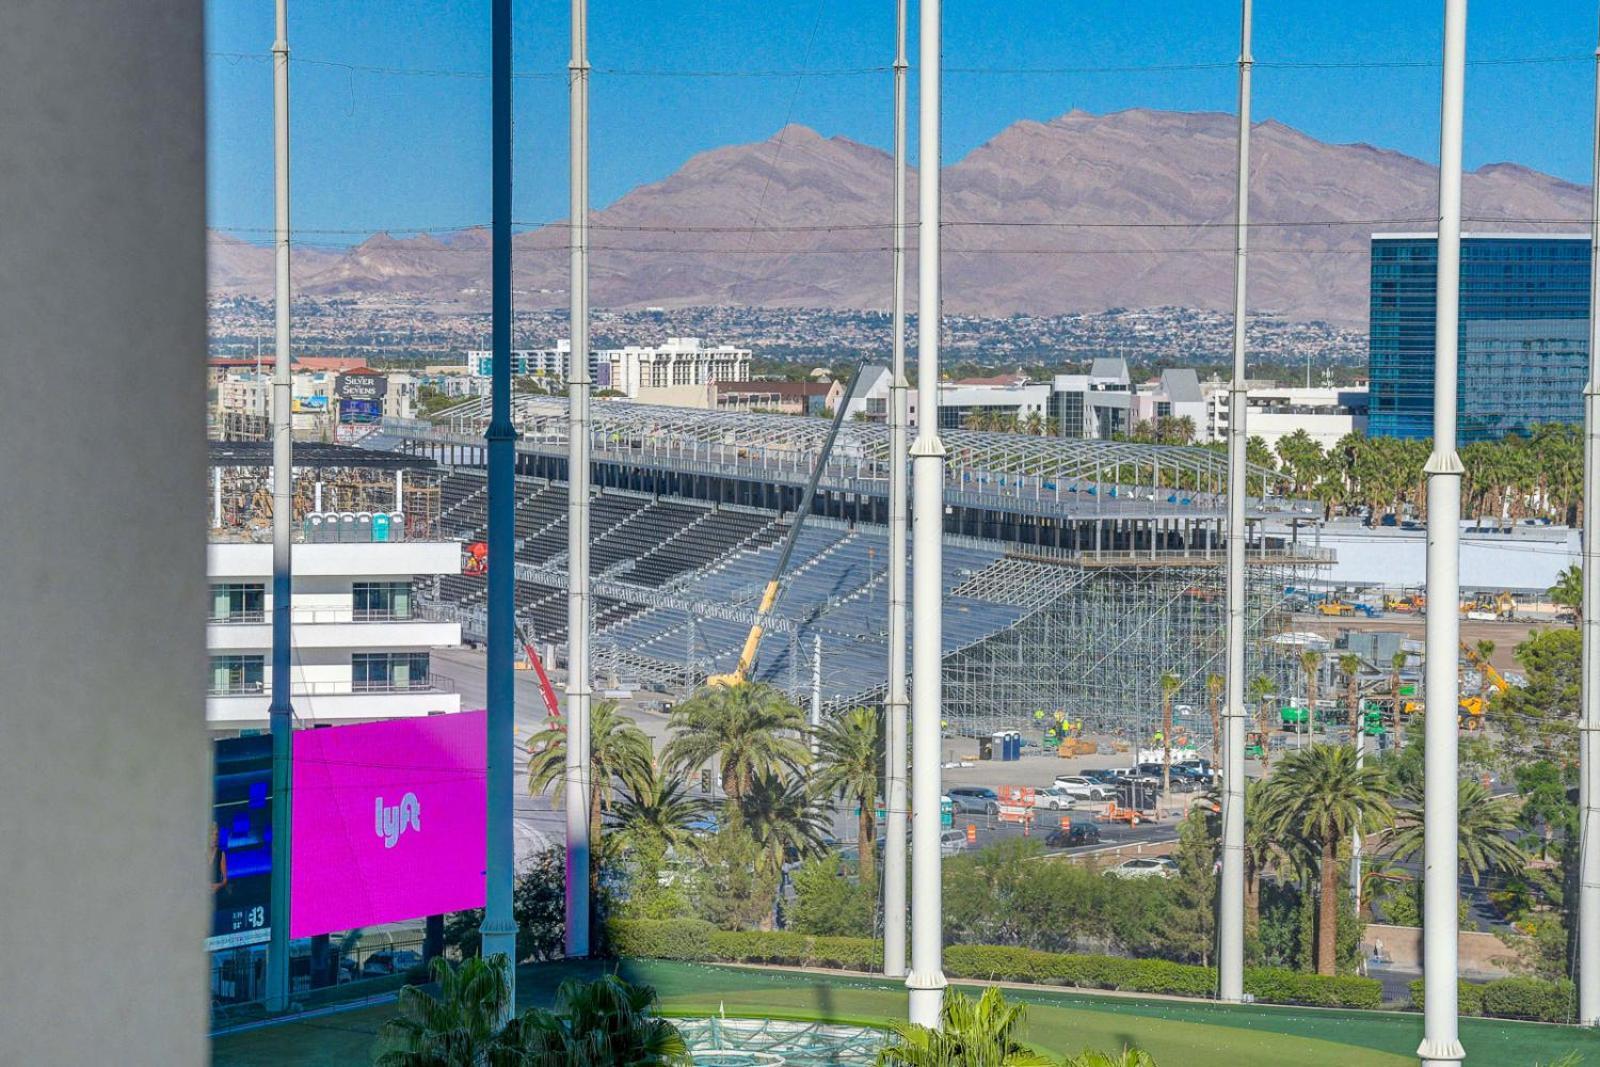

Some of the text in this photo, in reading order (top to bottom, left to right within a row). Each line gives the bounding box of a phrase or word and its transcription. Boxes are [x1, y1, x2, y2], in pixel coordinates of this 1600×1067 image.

[345, 376, 375, 385] SILVER
[342, 385, 376, 394] SEVENS
[375, 792, 420, 848] lyft
